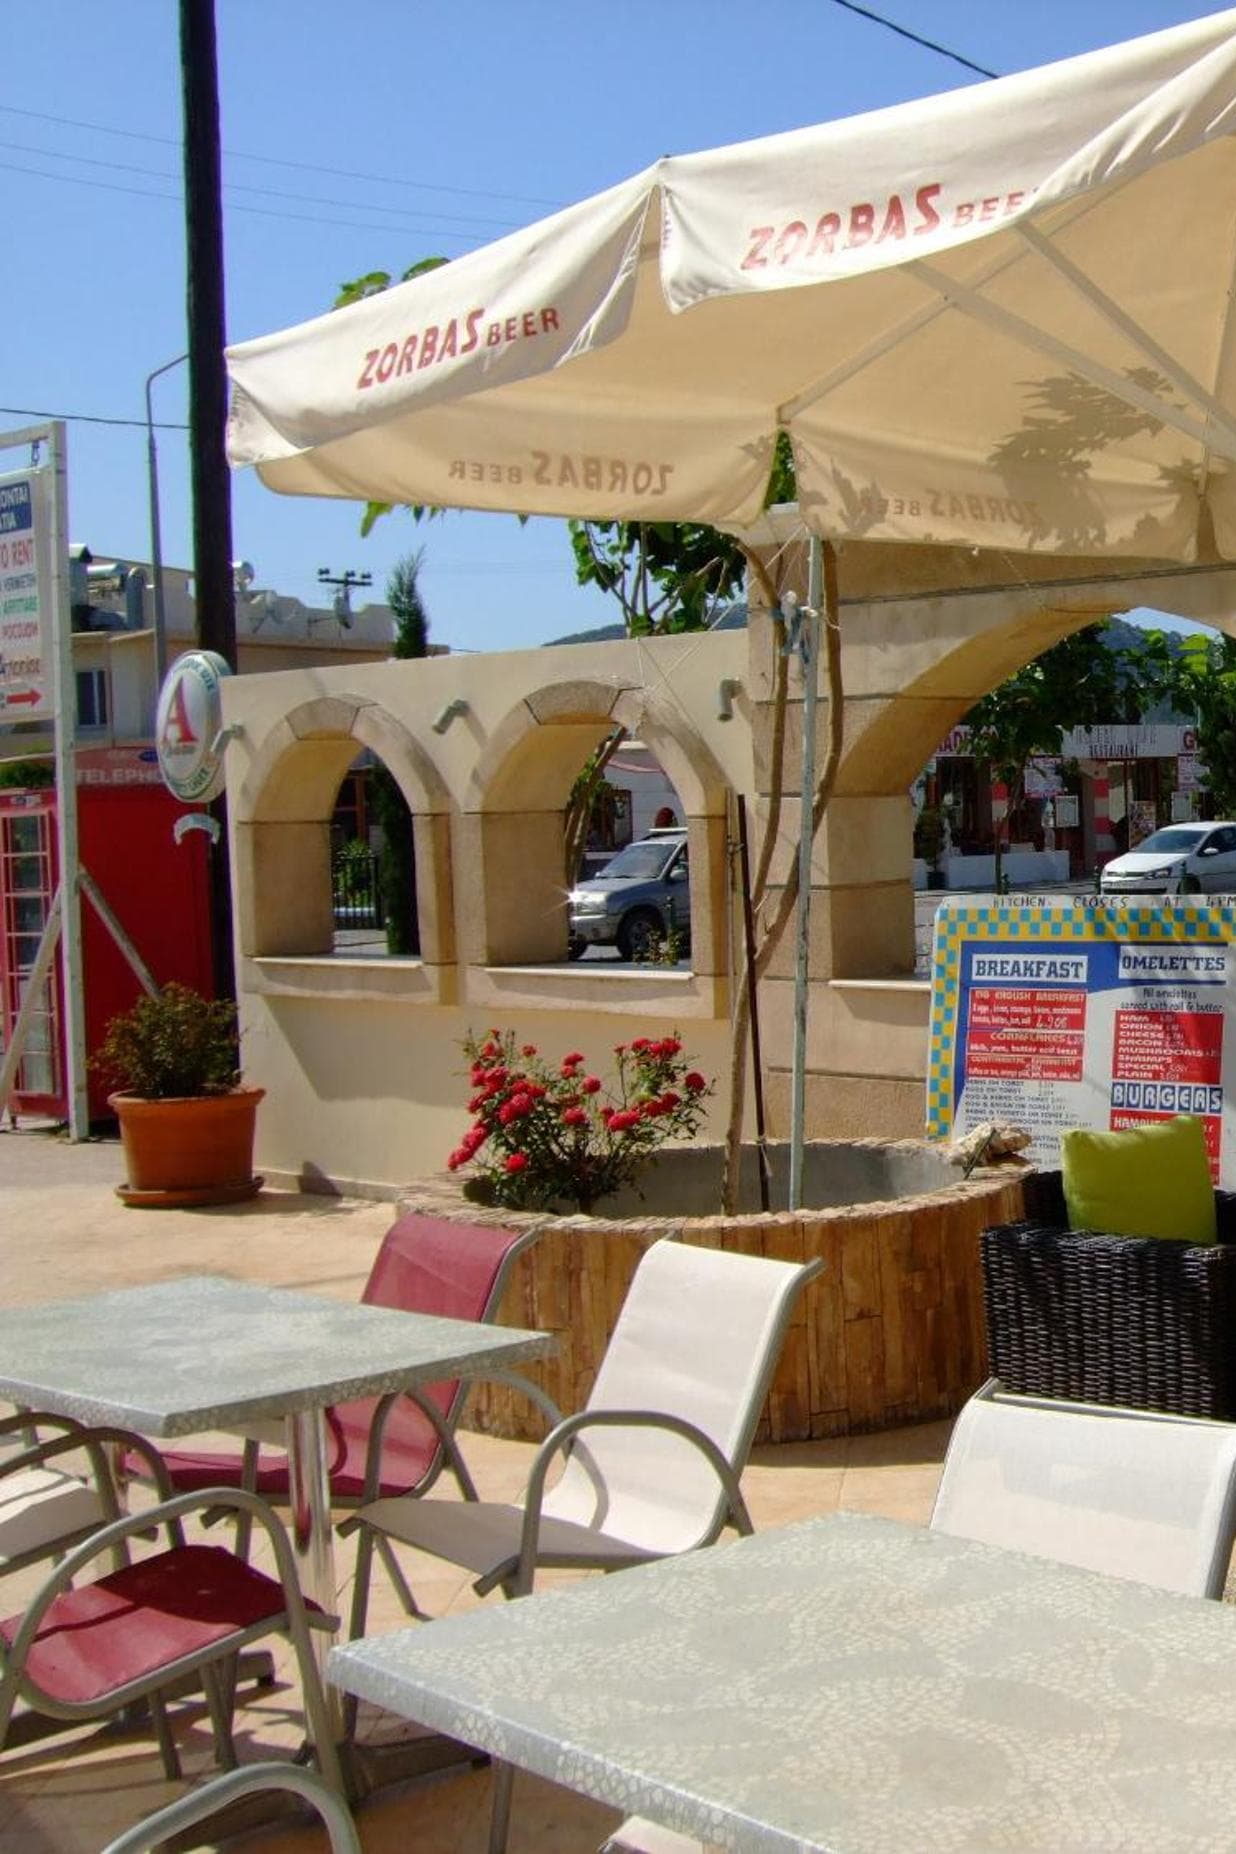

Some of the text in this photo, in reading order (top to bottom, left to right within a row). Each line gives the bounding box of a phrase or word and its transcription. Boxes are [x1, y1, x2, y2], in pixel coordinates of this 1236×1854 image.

[740, 183, 1042, 270] ZORBAS BEE
[357, 307, 560, 389] ZORBAS BEER
[993, 896, 1046, 908] KITCHEN
[1073, 896, 1129, 909] CLOSES
[975, 960, 1084, 978] BREAKFAST
[1121, 955, 1226, 971] OMELETTES
[1118, 1047, 1203, 1057] MUSHROOMS
[1117, 1063, 1166, 1071] SPECIAL
[1117, 1070, 1152, 1078] PLAIN
[1113, 1083, 1221, 1111] BURGERS
